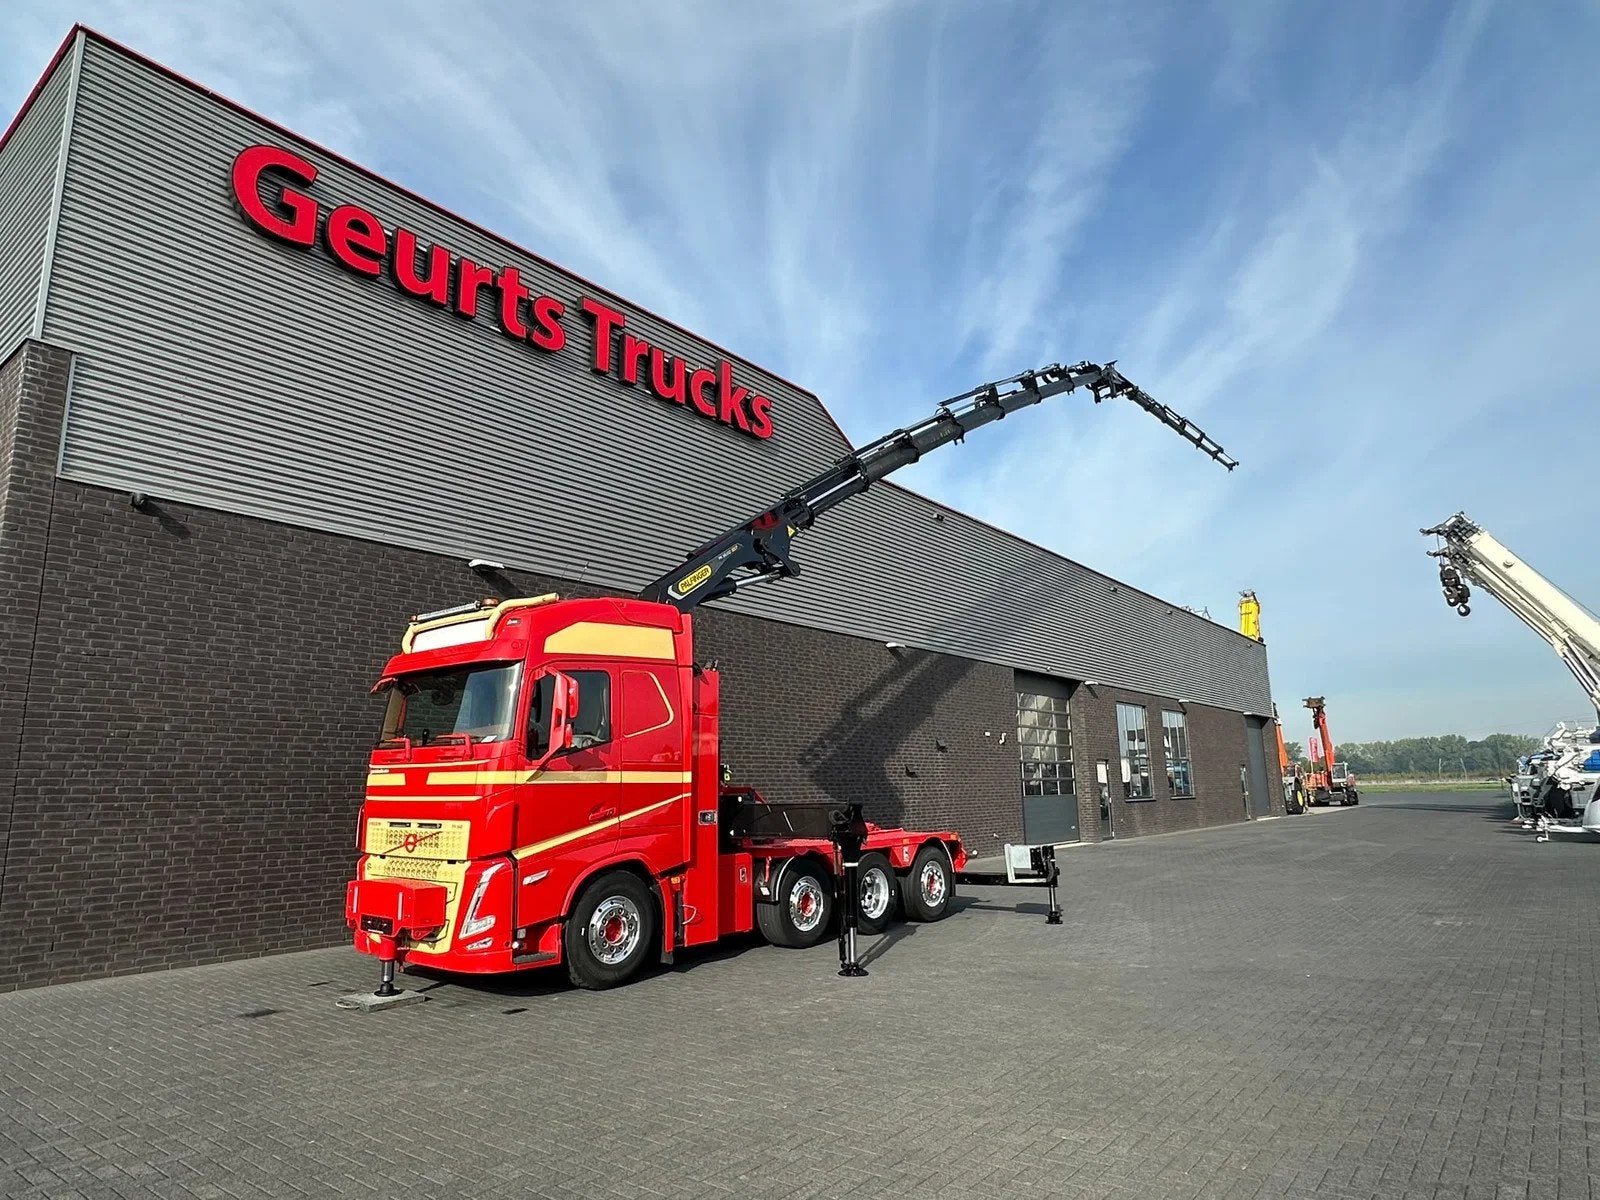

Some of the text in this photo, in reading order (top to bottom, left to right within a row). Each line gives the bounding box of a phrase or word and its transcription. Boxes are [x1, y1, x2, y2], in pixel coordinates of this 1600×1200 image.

[230, 145, 774, 440] Geurts Trucks
[680, 567, 710, 591] PALFINGER
